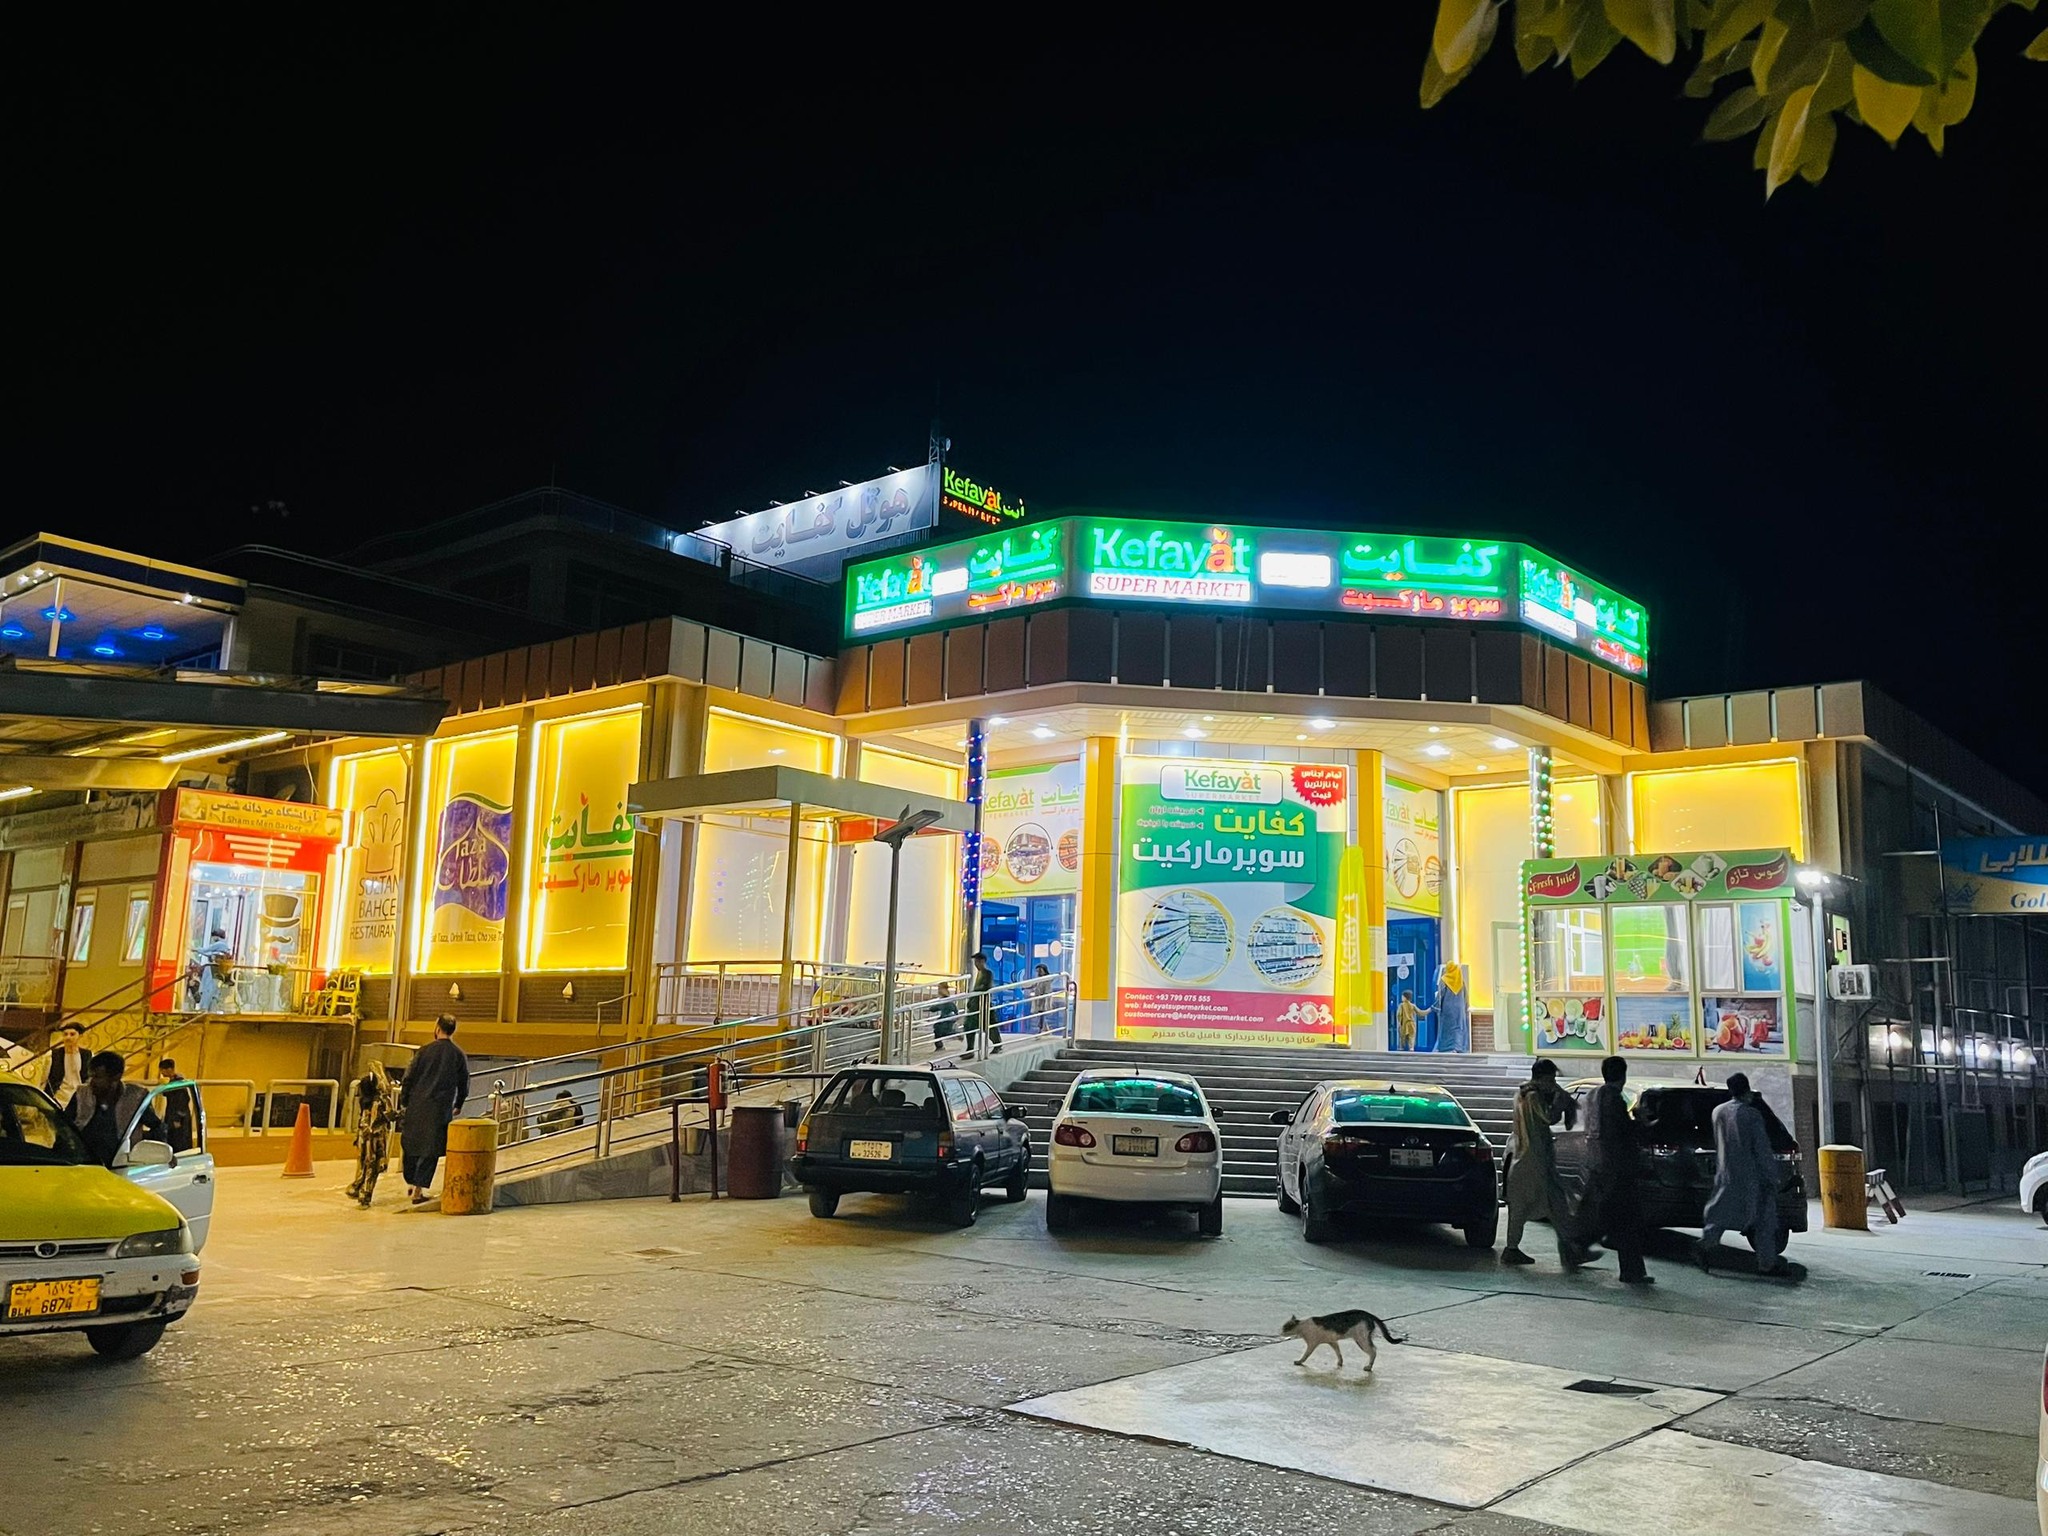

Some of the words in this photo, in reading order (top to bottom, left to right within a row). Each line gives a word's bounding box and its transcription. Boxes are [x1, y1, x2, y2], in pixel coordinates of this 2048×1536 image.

[846, 486, 912, 540] هوتل
[969, 526, 1058, 577] کفایت
[1093, 527, 1250, 578] Kefayat
[1343, 540, 1499, 581] کفایت
[856, 556, 933, 603] Kefayat
[1094, 576, 1158, 593] SUPER
[1162, 580, 1247, 598] MARKET
[1184, 769, 1261, 793] Kefayat
[1214, 808, 1305, 840] کفایت
[1531, 874, 1554, 893] Fresh
[1556, 870, 1576, 888] Juice
[1730, 868, 1749, 885] تازه
[1753, 862, 1785, 880] جوس
[358, 898, 397, 921] BAHÇE
[2010, 892, 2048, 909] Gol
[350, 924, 397, 940] RESTAURAN
[1340, 892, 1356, 975] Kefayt
[1124, 992, 1154, 1001] Contact:
[1155, 993, 1168, 1001] +93
[1142, 1002, 1229, 1013] kefayatsupermarket.com
[41, 1297, 72, 1314] 6874
